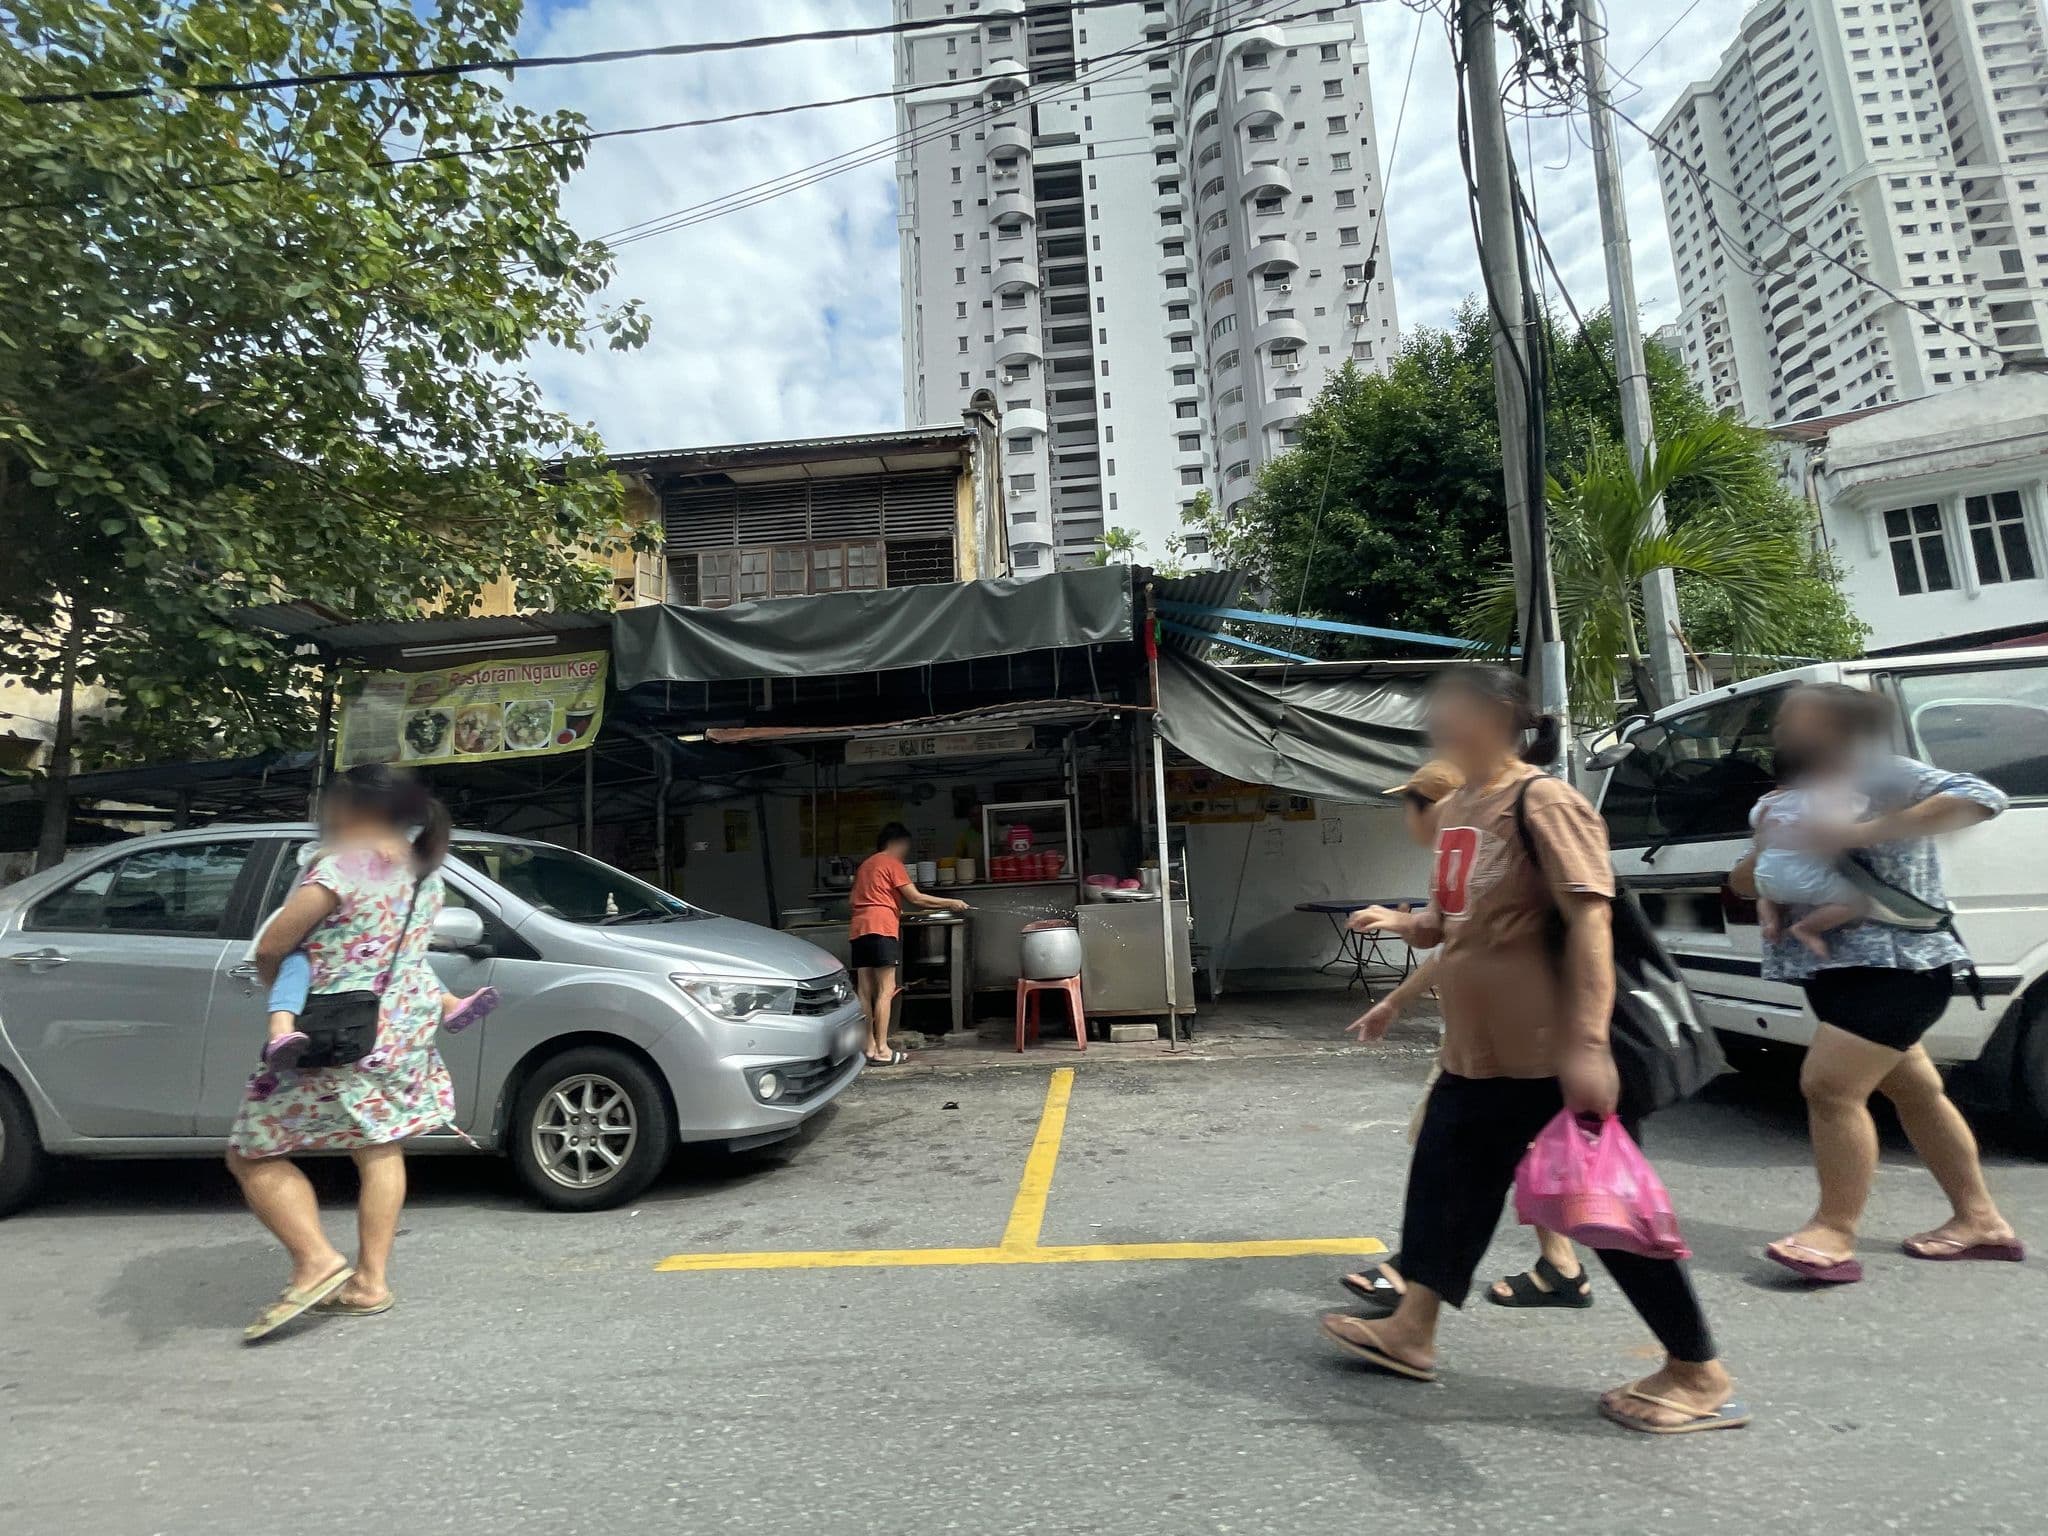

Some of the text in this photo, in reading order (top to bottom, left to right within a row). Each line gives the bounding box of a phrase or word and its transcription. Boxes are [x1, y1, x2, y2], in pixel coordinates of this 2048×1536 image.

[449, 660, 599, 686] Restoran Ngau Kee
